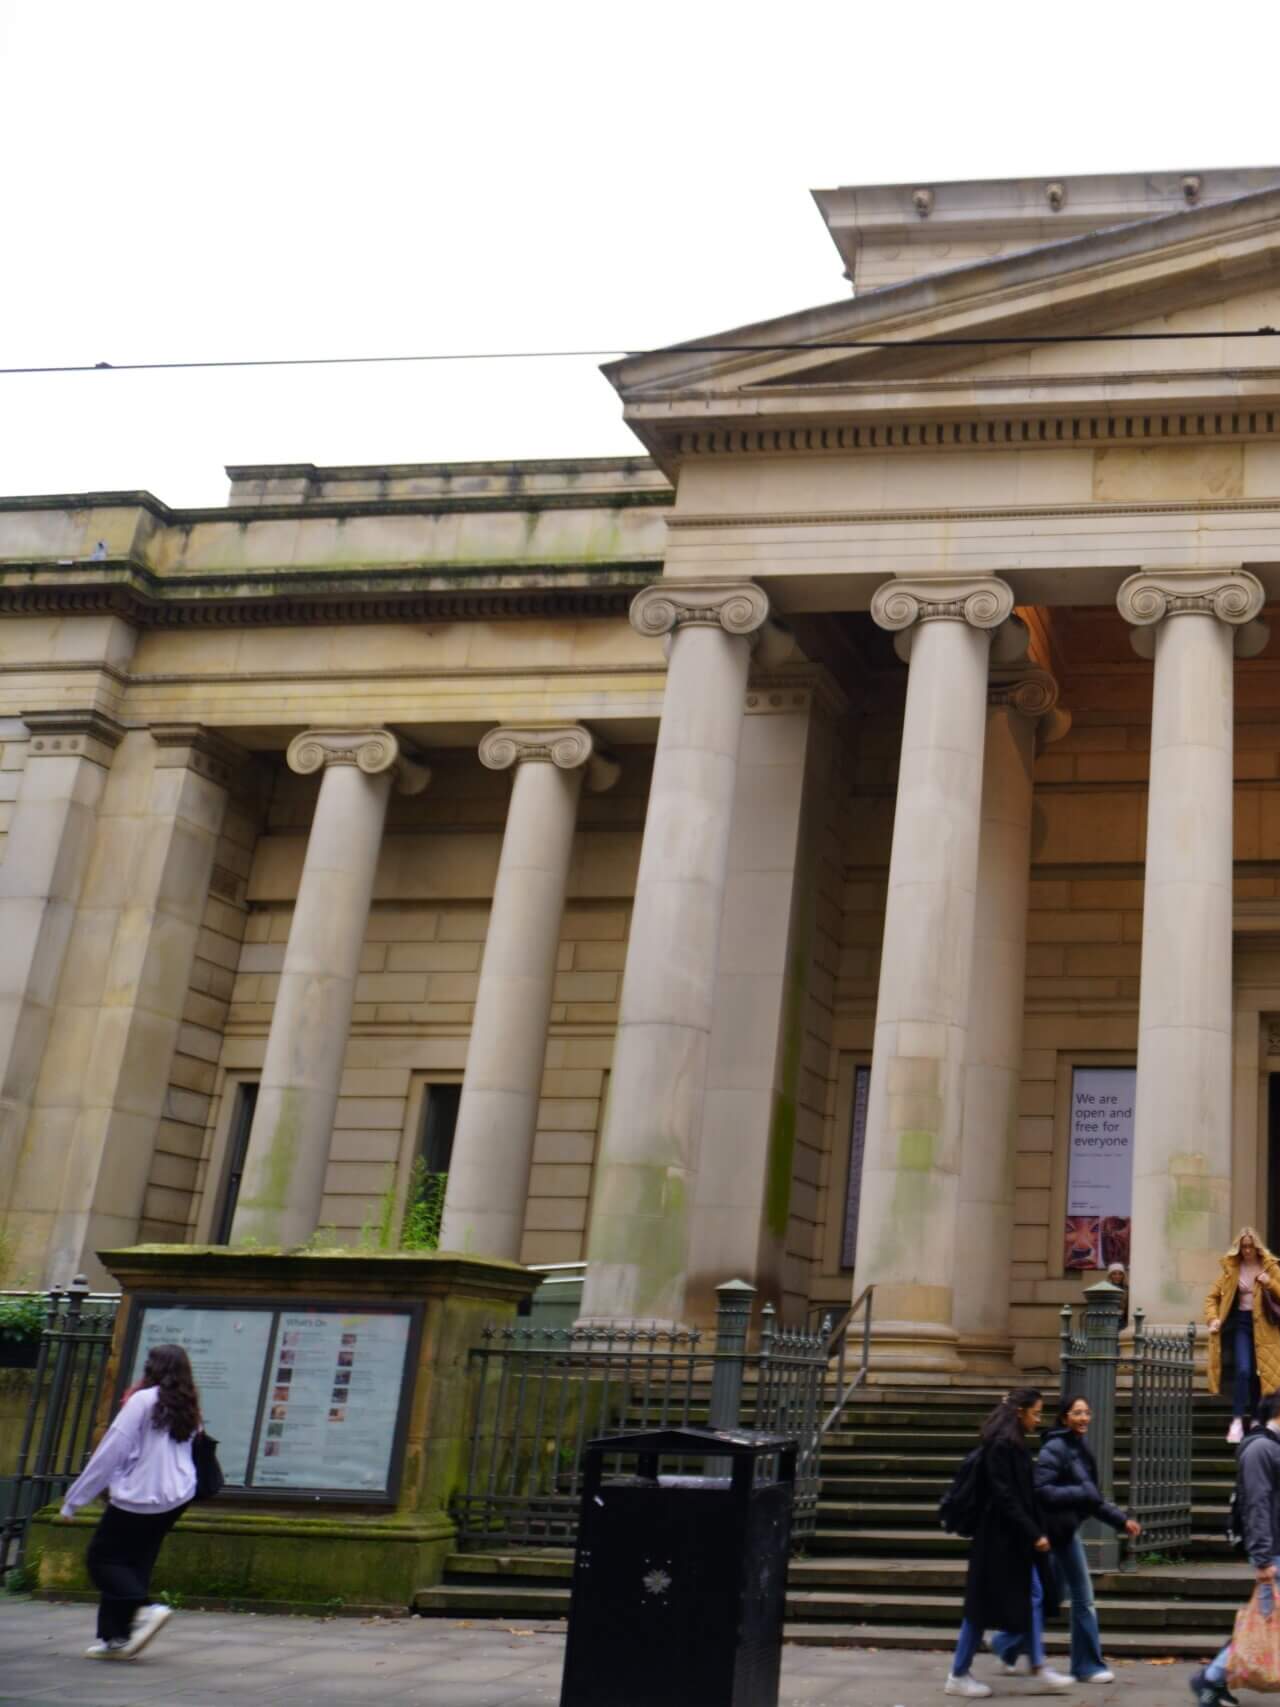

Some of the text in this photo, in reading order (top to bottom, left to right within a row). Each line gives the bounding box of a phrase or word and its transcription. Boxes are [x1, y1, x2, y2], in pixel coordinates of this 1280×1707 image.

[1075, 1093, 1118, 1105] We are
[1075, 1107, 1132, 1121] open and
[1075, 1121, 1120, 1132] free for
[1074, 1136, 1128, 1148] everyone
